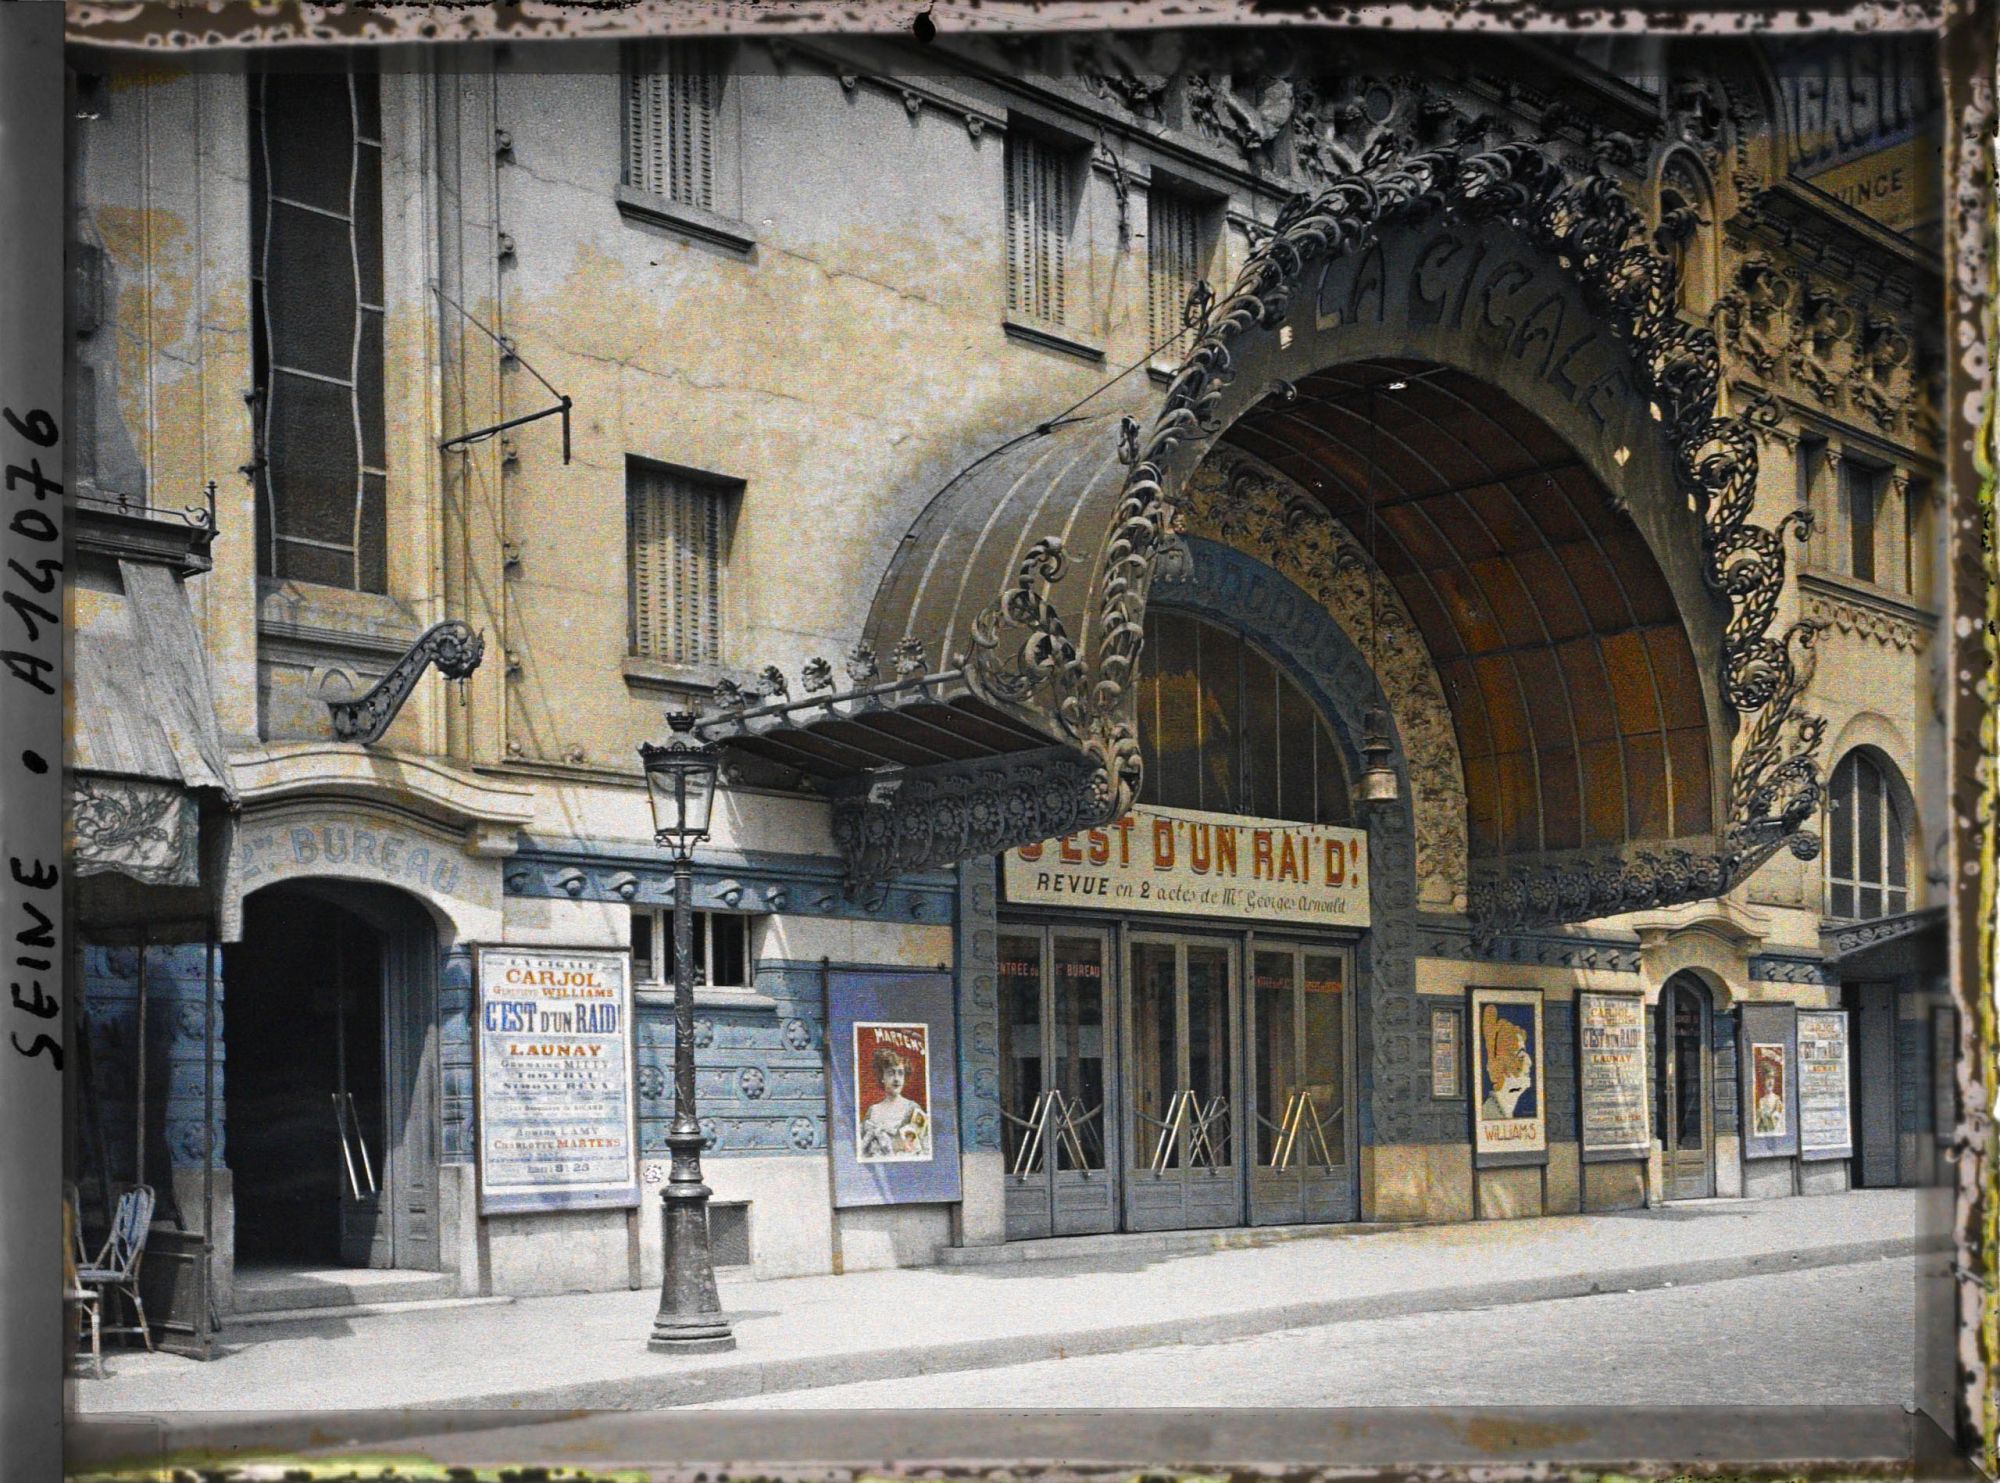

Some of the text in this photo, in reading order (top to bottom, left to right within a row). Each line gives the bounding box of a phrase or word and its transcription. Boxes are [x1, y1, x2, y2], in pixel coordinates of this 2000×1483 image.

[1315, 234, 1631, 432] LA CIGALE
[291, 826, 460, 895] BUREAU
[1153, 819, 1237, 877] D'UN
[1037, 873, 1109, 896] REVUE
[1116, 883, 1133, 898] en
[1140, 881, 1151, 899] 2
[1157, 884, 1195, 902] actes
[1200, 887, 1218, 905] de
[1245, 890, 1295, 914] Georges
[10, 858, 63, 1073] SEINE
[505, 969, 600, 988] CARJOL
[1066, 963, 1102, 978] BUREAU
[541, 987, 614, 999] WILLIAMS
[486, 1001, 622, 1034] C'EST D'UN RAID!
[510, 1043, 602, 1057] LAUNAY
[873, 1028, 925, 1056] MARTENS
[556, 1138, 621, 1149] MARTENS
[1484, 1123, 1537, 1142] WILLIAMS
